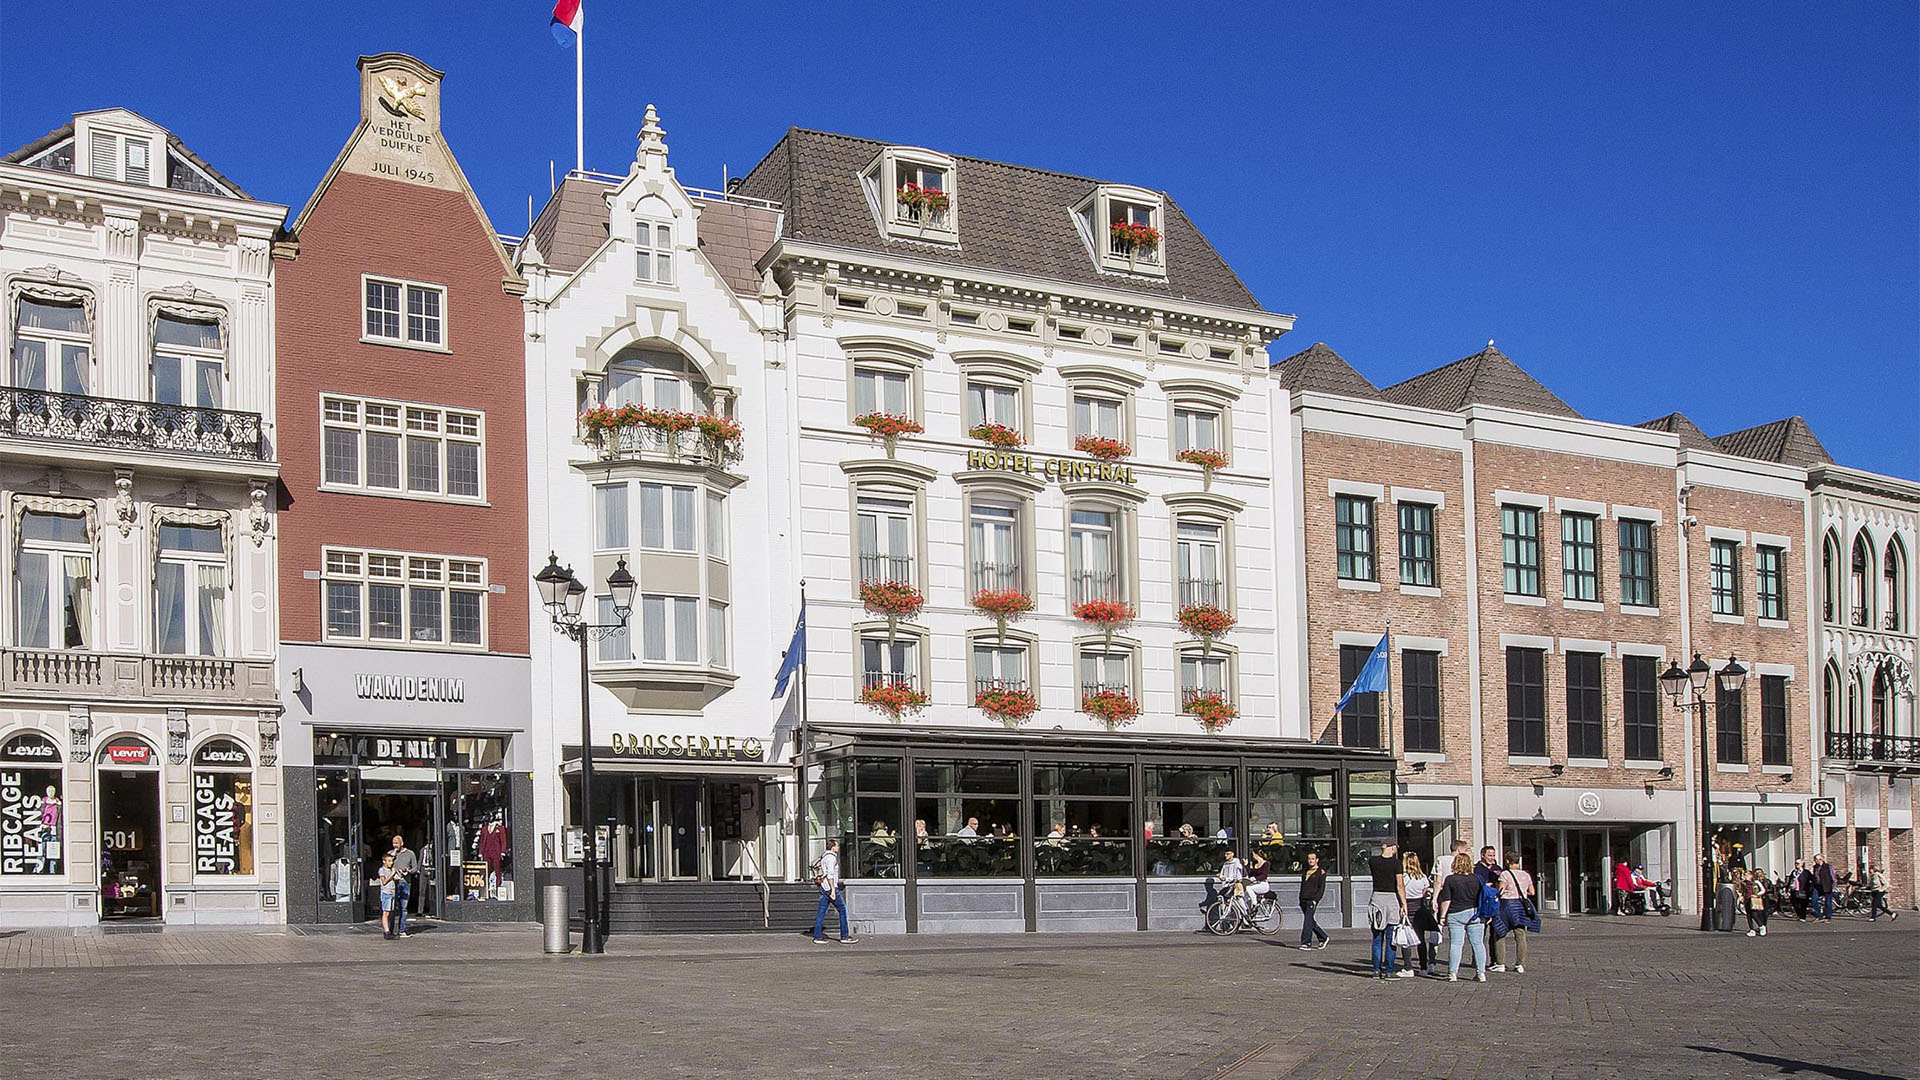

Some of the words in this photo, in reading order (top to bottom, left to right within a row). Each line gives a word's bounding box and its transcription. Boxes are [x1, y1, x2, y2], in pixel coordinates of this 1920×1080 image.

[371, 125, 431, 144] VERGULDE
[390, 120, 411, 131] HET
[381, 139, 422, 153] DUIFKE
[371, 162, 399, 176] JULI
[405, 168, 435, 183] 1945
[968, 450, 1038, 472] HOTEL
[1045, 459, 1137, 483] CENTRAL
[612, 732, 737, 758] BRASSERIE
[1, 772, 24, 873] RIBCAGE
[22, 794, 46, 874] JEANS
[195, 775, 216, 872] RIBCAGE
[215, 793, 236, 872] JEANS
[103, 830, 136, 849] 501
[463, 874, 485, 887] 50%
